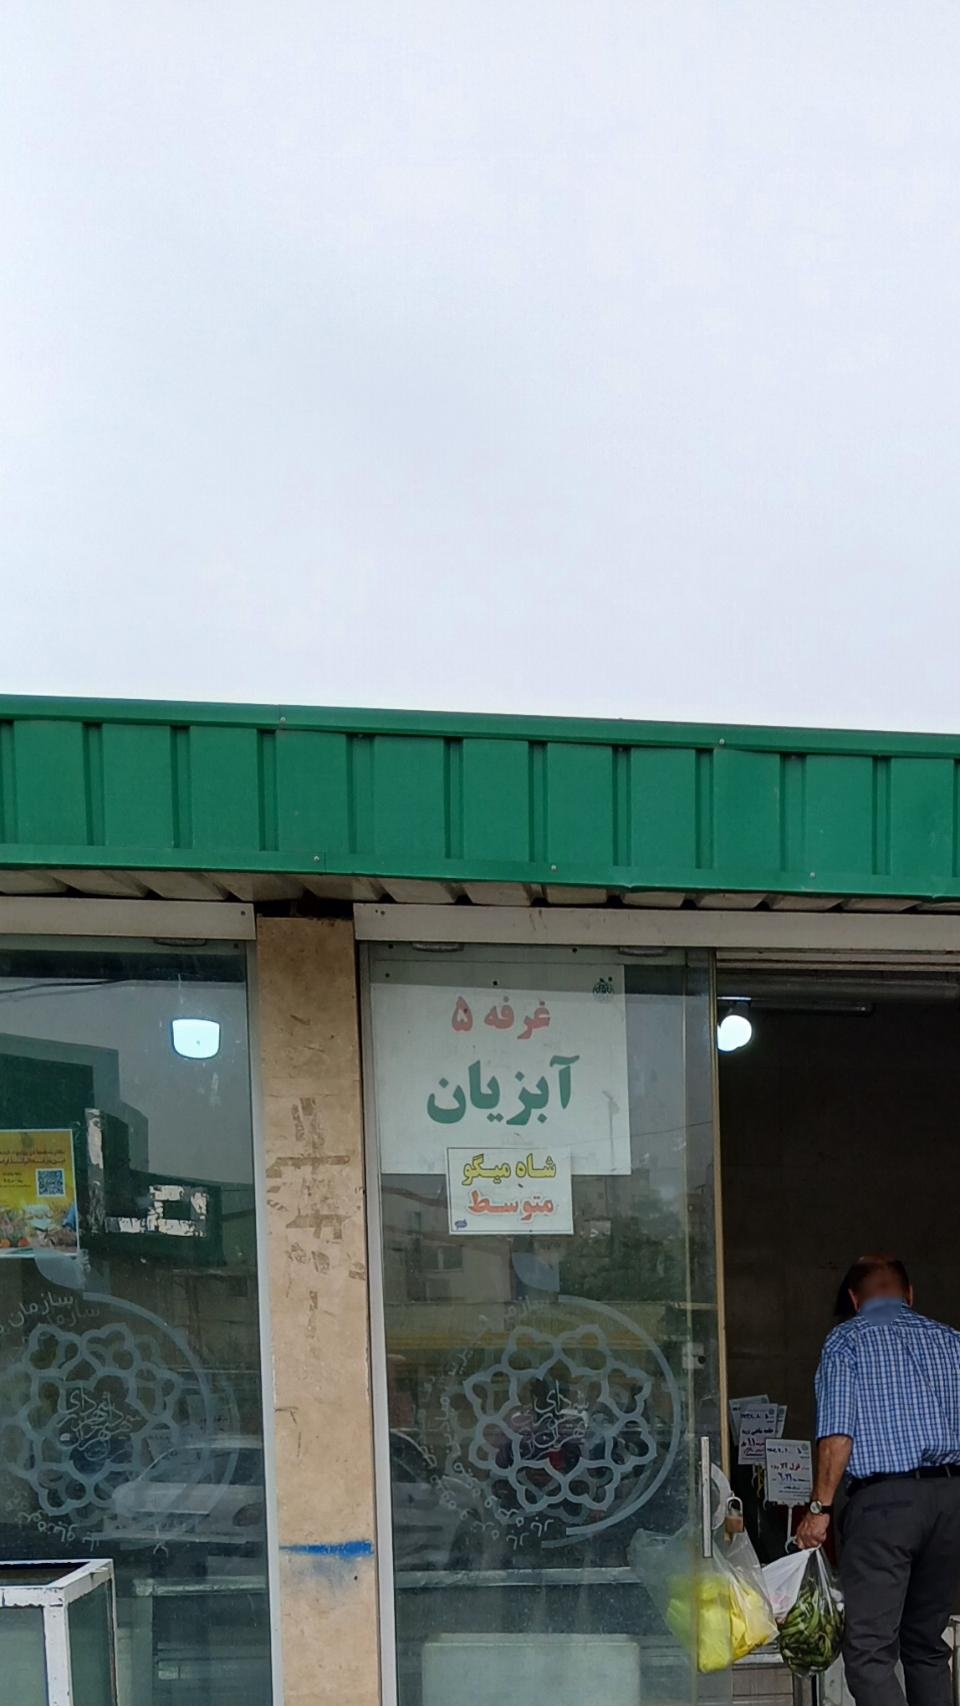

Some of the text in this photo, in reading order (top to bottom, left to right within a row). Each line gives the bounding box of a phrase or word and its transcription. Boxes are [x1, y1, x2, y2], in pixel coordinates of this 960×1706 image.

[451, 996, 551, 1040] غرفه ۵
[427, 1055, 580, 1126] آبزیان
[462, 1152, 556, 1186] شاه میگو
[468, 1190, 554, 1222] متوسط
[8, 1291, 74, 1328] سازمان
[530, 1516, 554, 1537] بار
